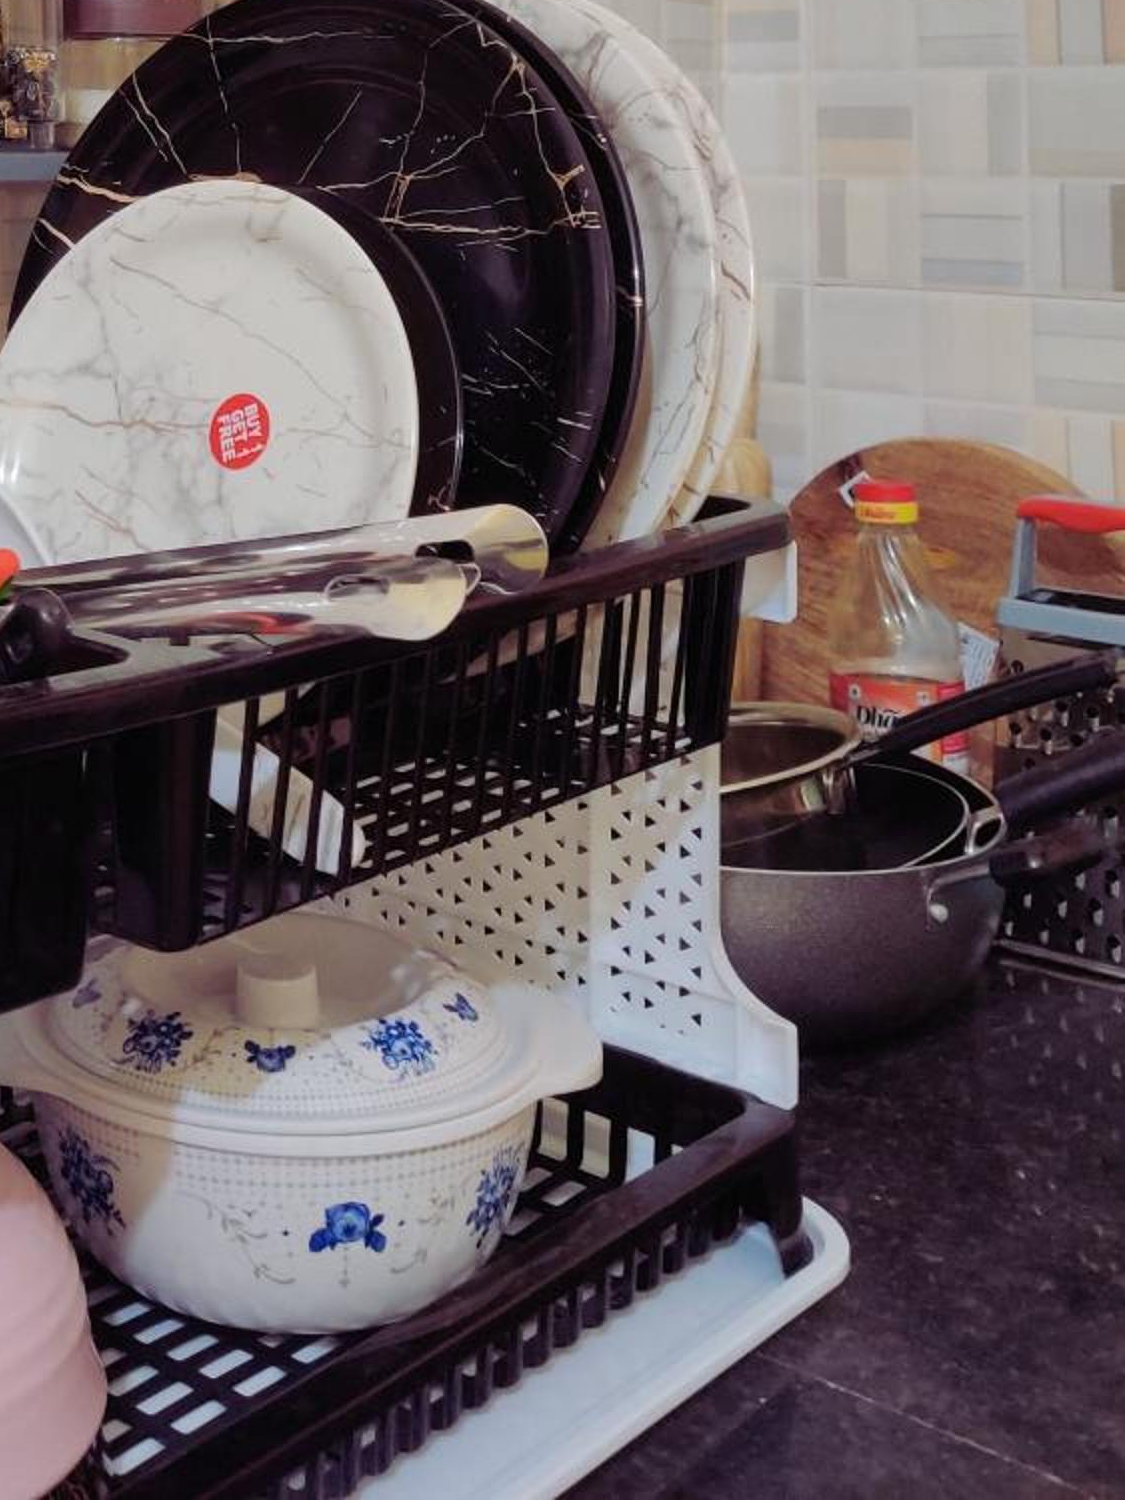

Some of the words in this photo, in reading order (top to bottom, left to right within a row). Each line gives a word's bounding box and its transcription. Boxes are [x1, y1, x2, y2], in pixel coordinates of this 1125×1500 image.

[230, 409, 248, 442] GET
[245, 403, 262, 437] BUY
[216, 414, 236, 462] FREE
